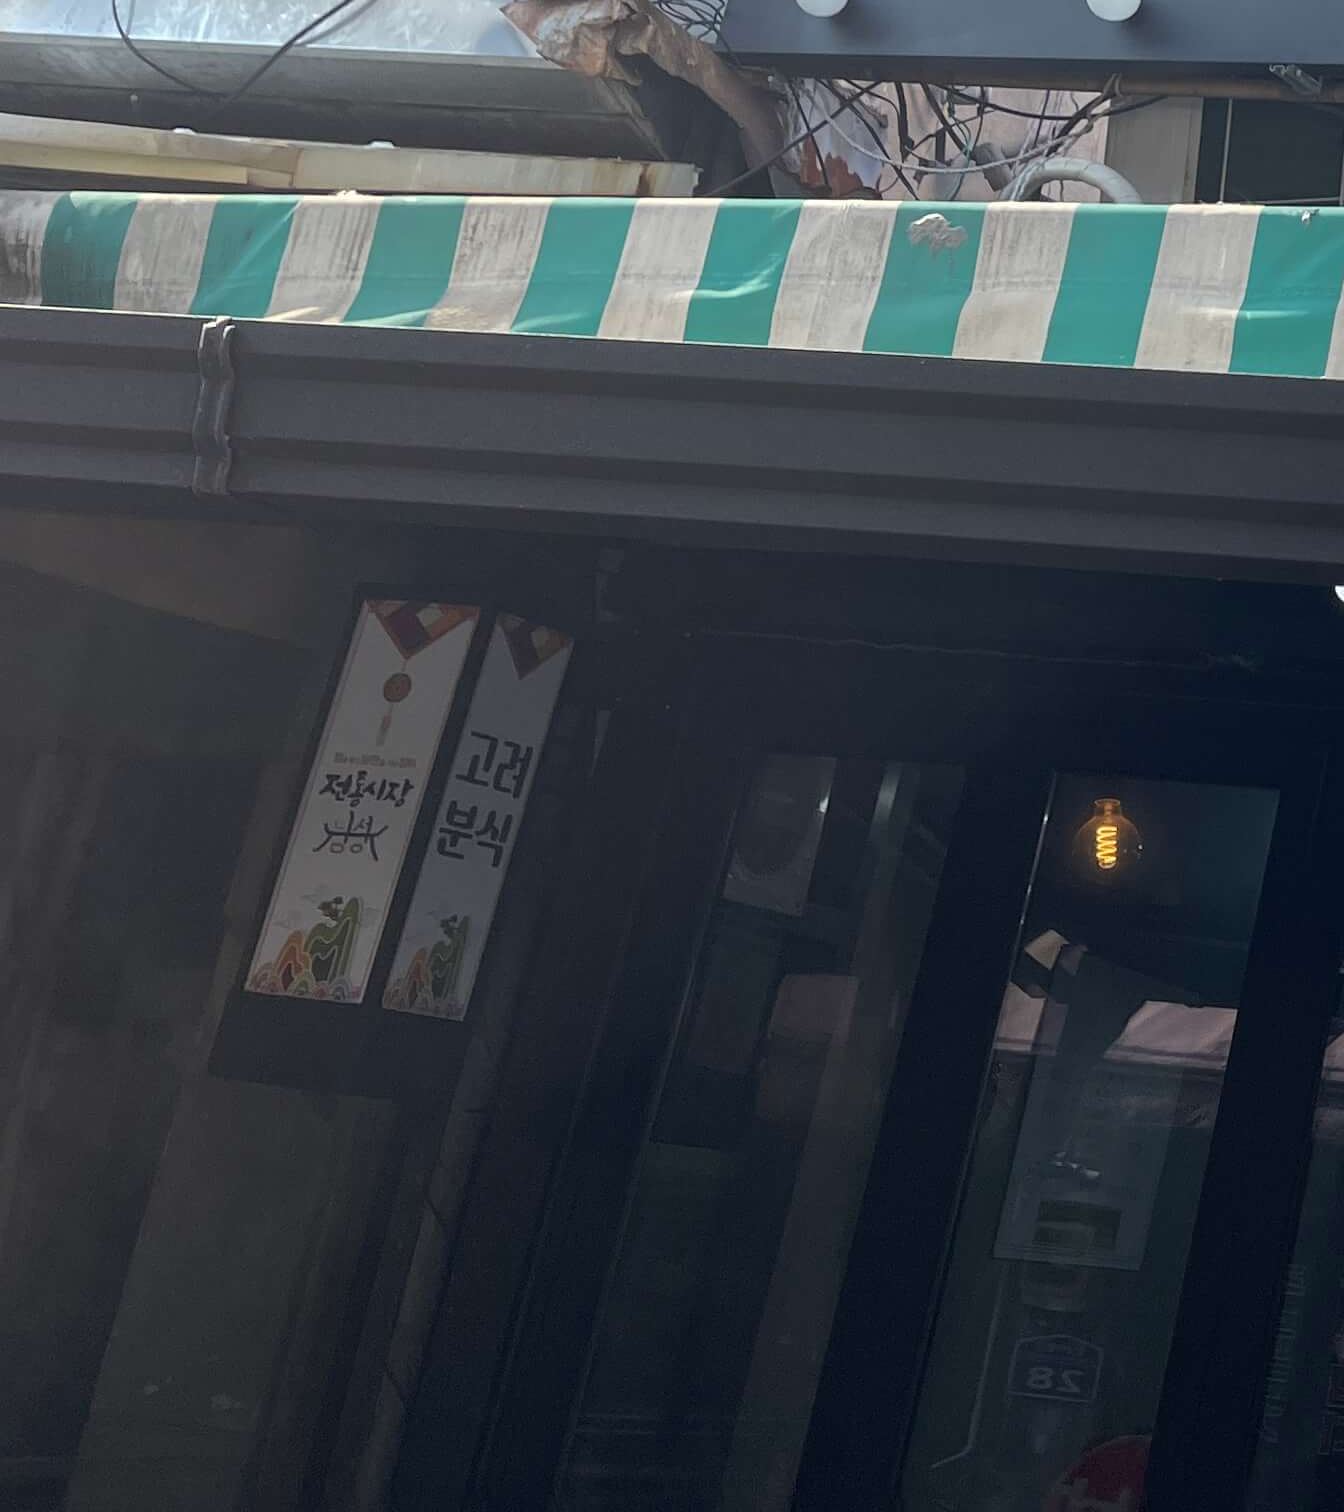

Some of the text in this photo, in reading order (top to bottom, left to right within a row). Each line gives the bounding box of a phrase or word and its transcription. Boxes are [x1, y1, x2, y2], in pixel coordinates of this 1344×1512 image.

[318, 770, 415, 808] 전통시장
[455, 730, 533, 799] 고려
[436, 800, 513, 868] 분식
